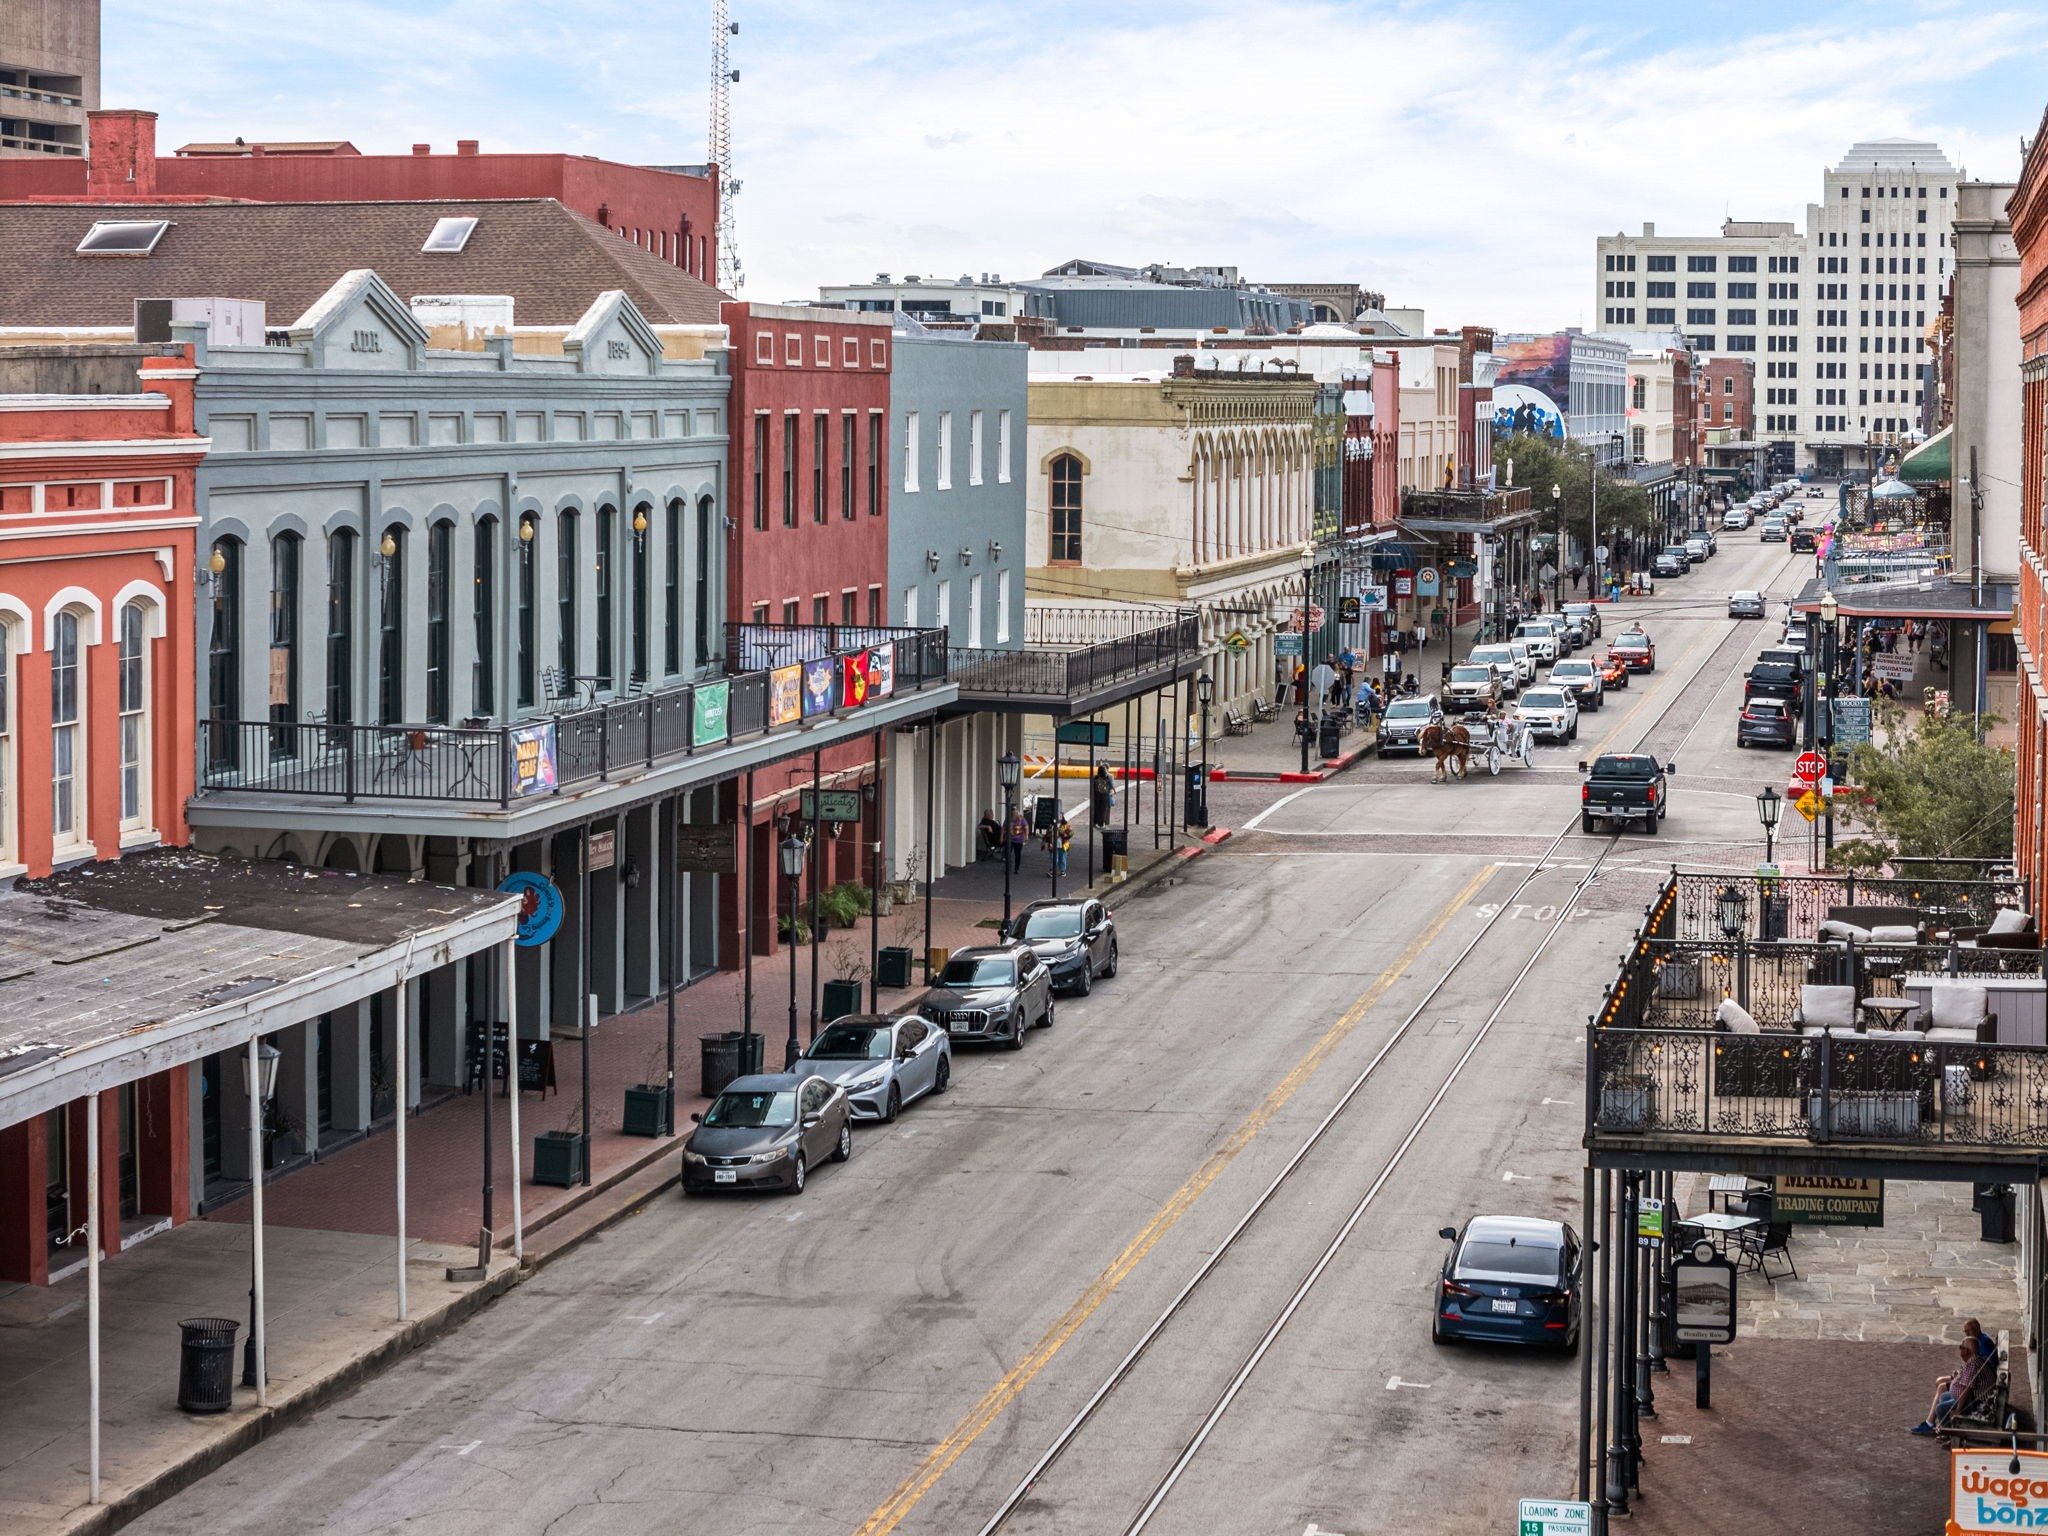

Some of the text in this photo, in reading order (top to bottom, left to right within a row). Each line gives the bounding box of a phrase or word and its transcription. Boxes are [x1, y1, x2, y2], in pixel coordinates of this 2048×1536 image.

[1875, 664, 1913, 673] LIQUIDATION
[1797, 761, 1825, 774] STOP
[1777, 1198, 1880, 1214] TRADING COMPANY
[1524, 1506, 1586, 1520] LOADING ZONE
[1525, 1522, 1538, 1532] 15
[1548, 1525, 1582, 1534] PASSENGER
